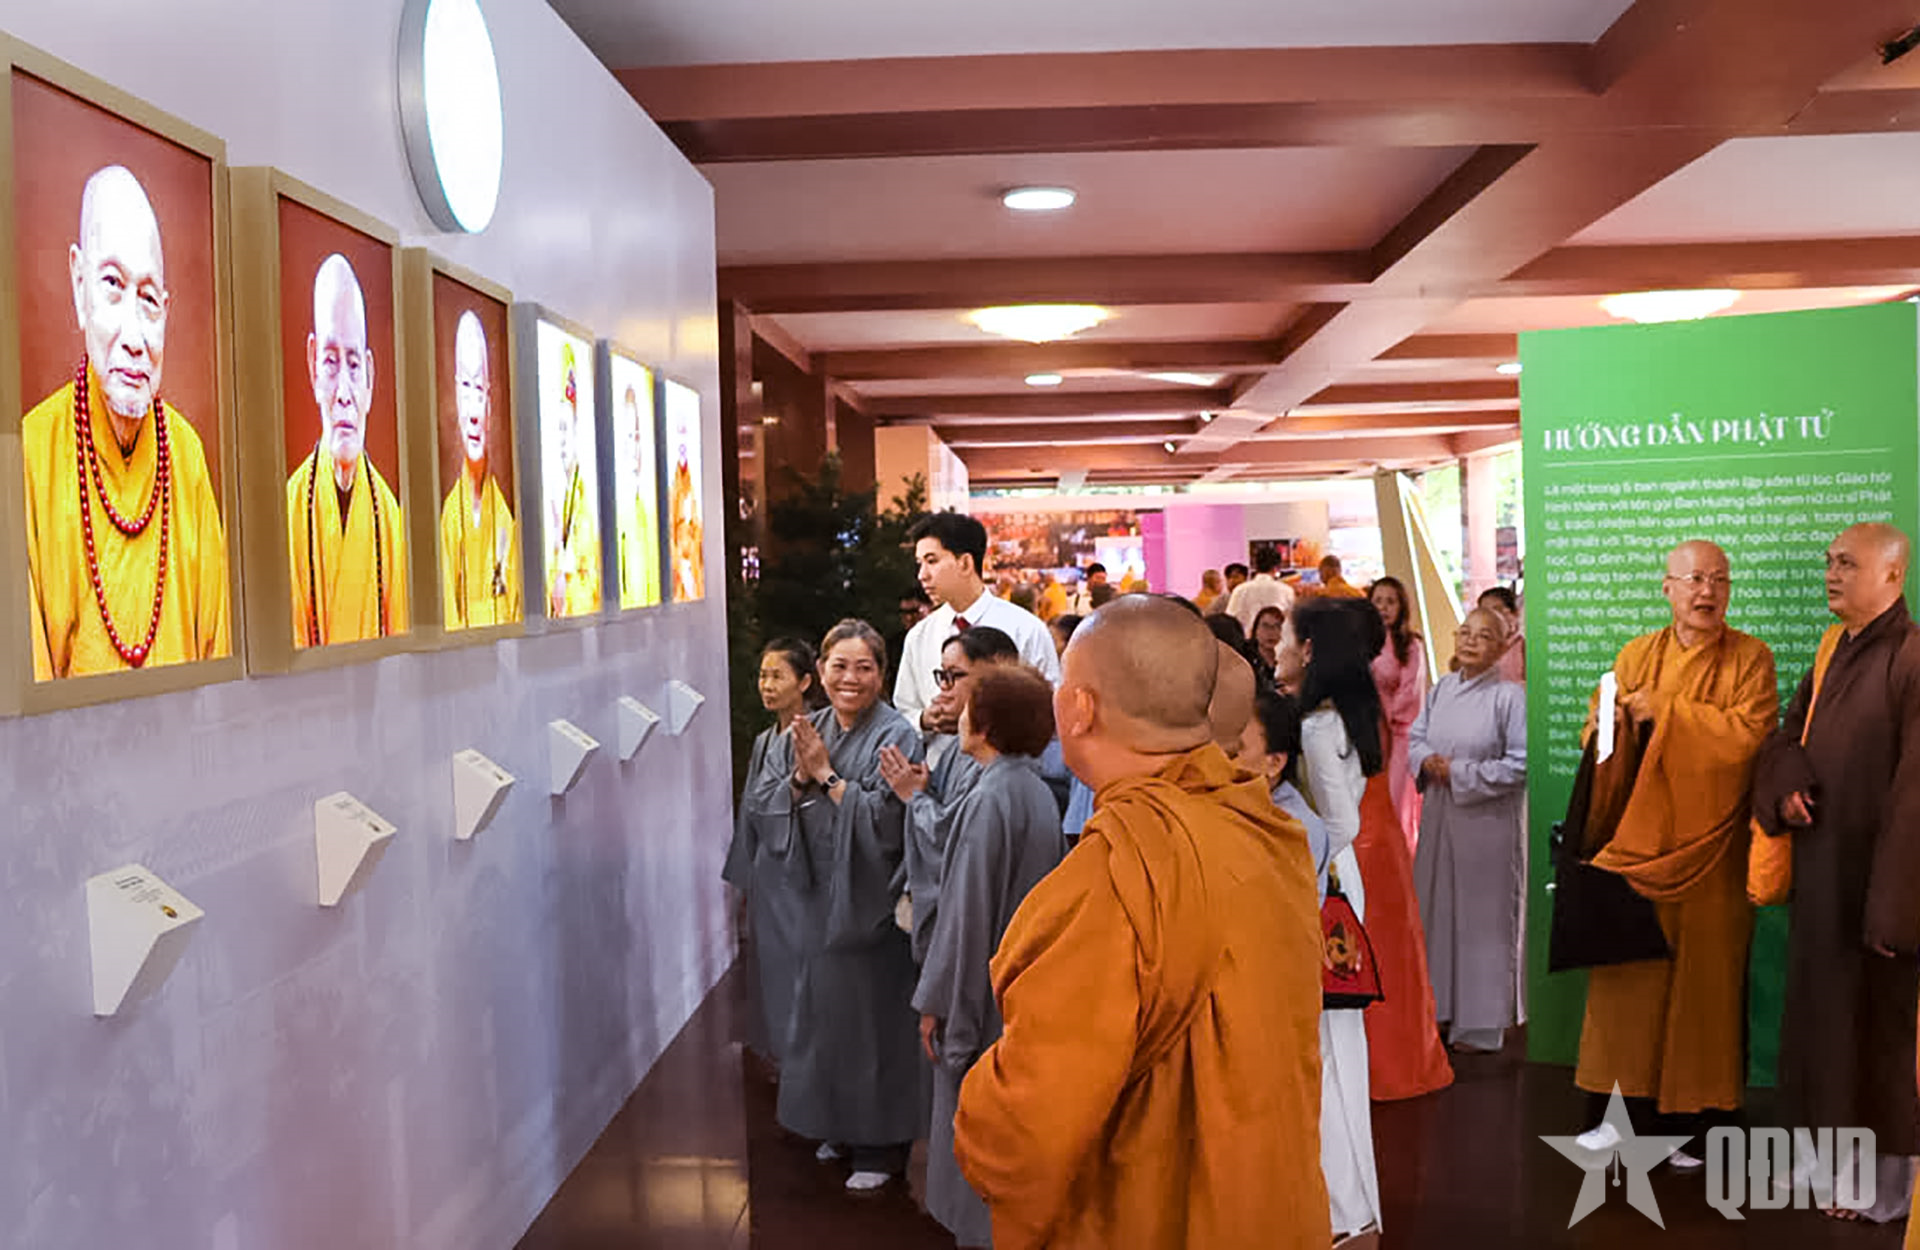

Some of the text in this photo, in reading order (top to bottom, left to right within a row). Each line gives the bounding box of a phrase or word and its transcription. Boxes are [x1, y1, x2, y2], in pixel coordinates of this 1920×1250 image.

[1543, 407, 1835, 451] HƯỚNG DẪN PHẬT TỬ
